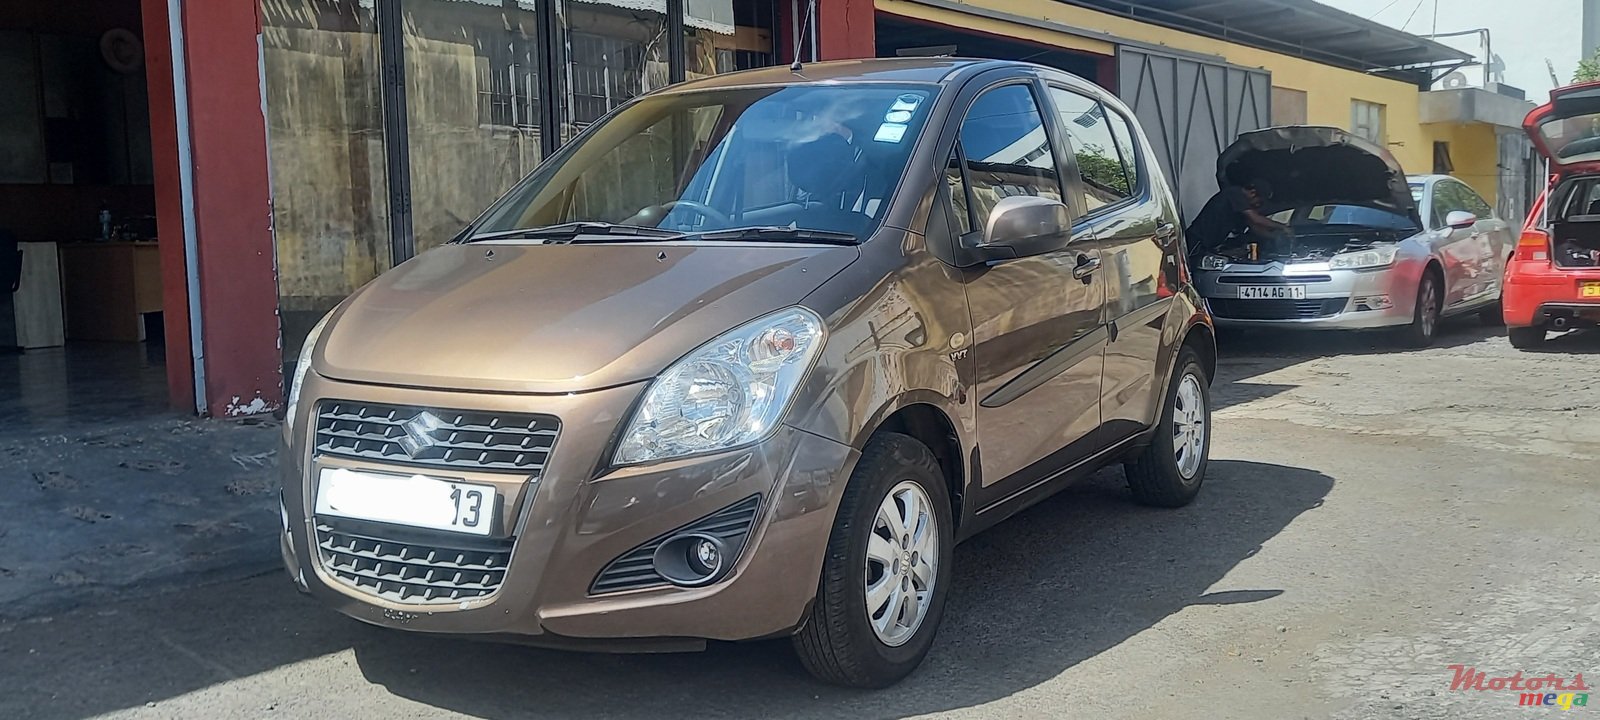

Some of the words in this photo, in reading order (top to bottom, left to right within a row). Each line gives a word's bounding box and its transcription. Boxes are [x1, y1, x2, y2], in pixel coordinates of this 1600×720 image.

[1244, 287, 1269, 298] 4714
[1271, 287, 1284, 298] AG
[1288, 287, 1299, 298] 11
[950, 349, 968, 361] VVT
[450, 488, 482, 527] 13
